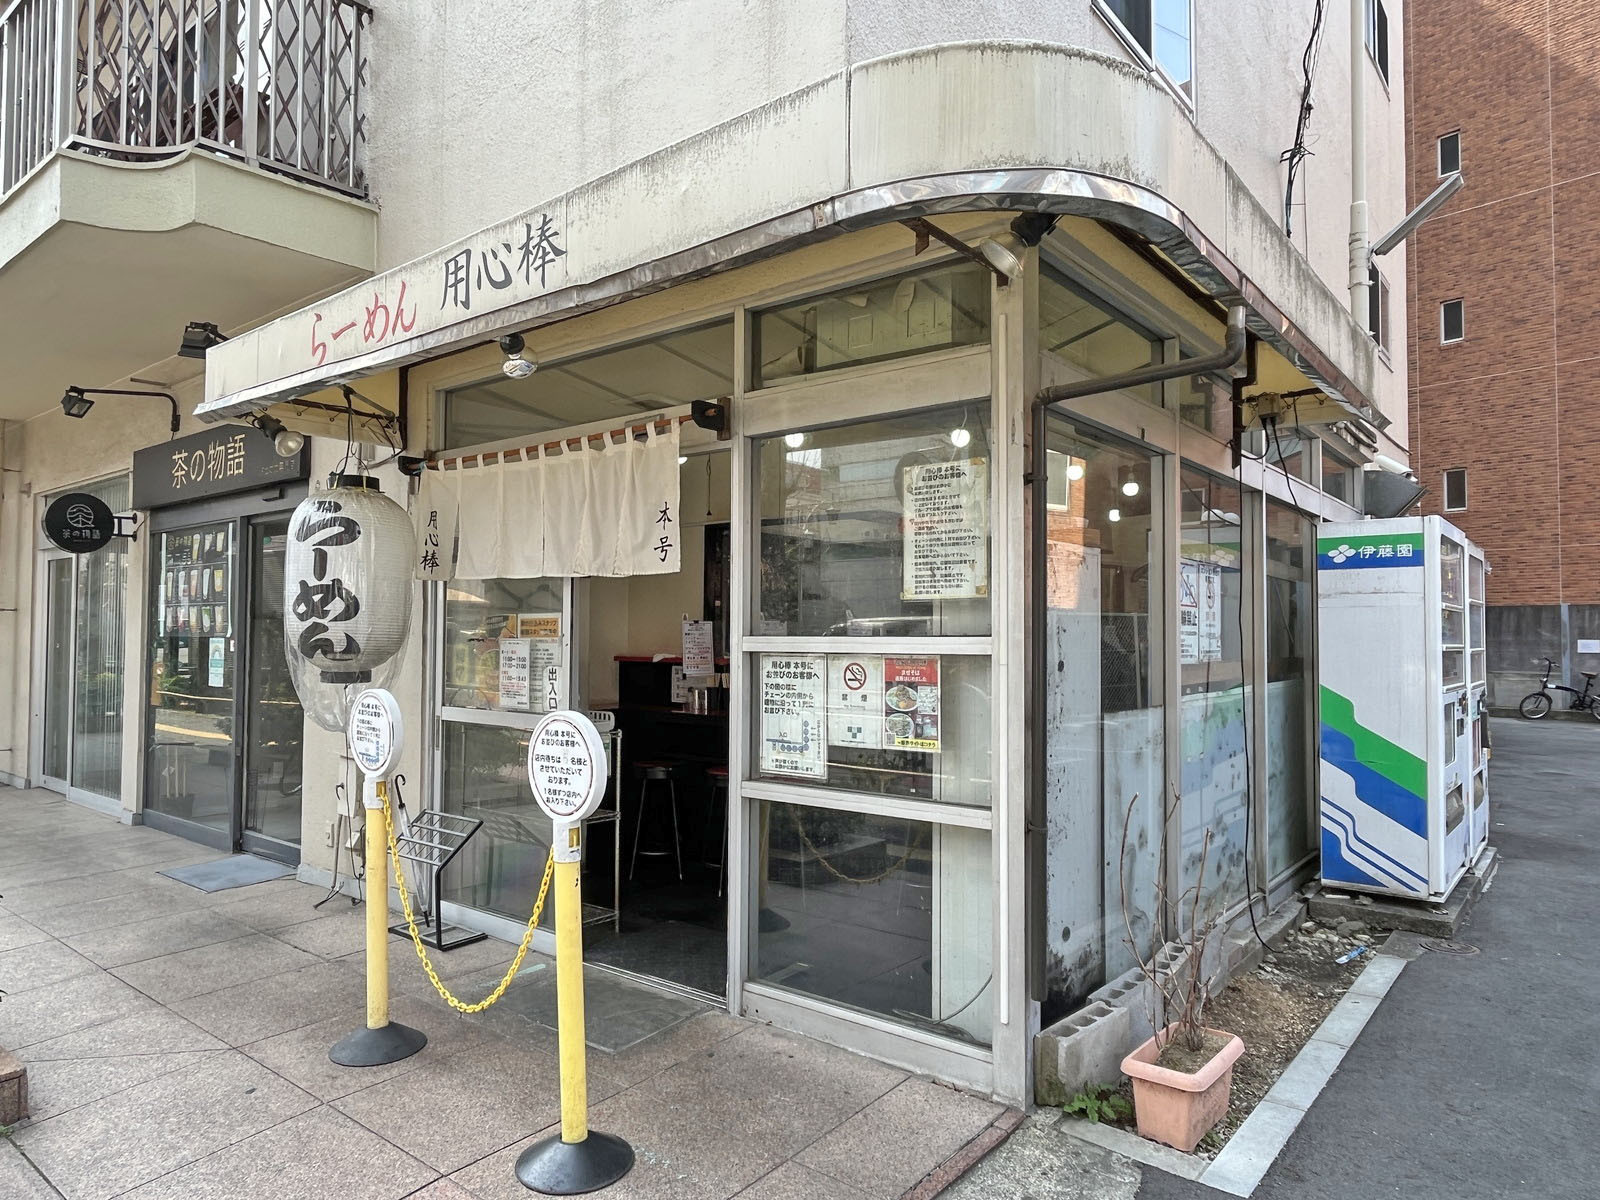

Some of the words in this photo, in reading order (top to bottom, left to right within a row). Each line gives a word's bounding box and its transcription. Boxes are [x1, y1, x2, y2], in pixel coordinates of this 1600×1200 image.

[311, 280, 416, 366] らーめん
[440, 213, 566, 311] 用心棒
[171, 433, 246, 489] 茶の物語
[653, 500, 673, 562] 本号
[1357, 543, 1413, 559] 伊藤園
[292, 500, 360, 662] らーめん
[793, 661, 814, 670] 本号に
[766, 670, 820, 680] お並びのお客様へ
[548, 667, 558, 710] 出入口
[560, 730, 576, 739] 本号に
[541, 738, 581, 748] お並びのお客様へ
[535, 754, 561, 763] 店内待ちは
[570, 757, 588, 766] 名様と
[539, 765, 583, 777] させていただいて
[548, 776, 571, 785] おります。
